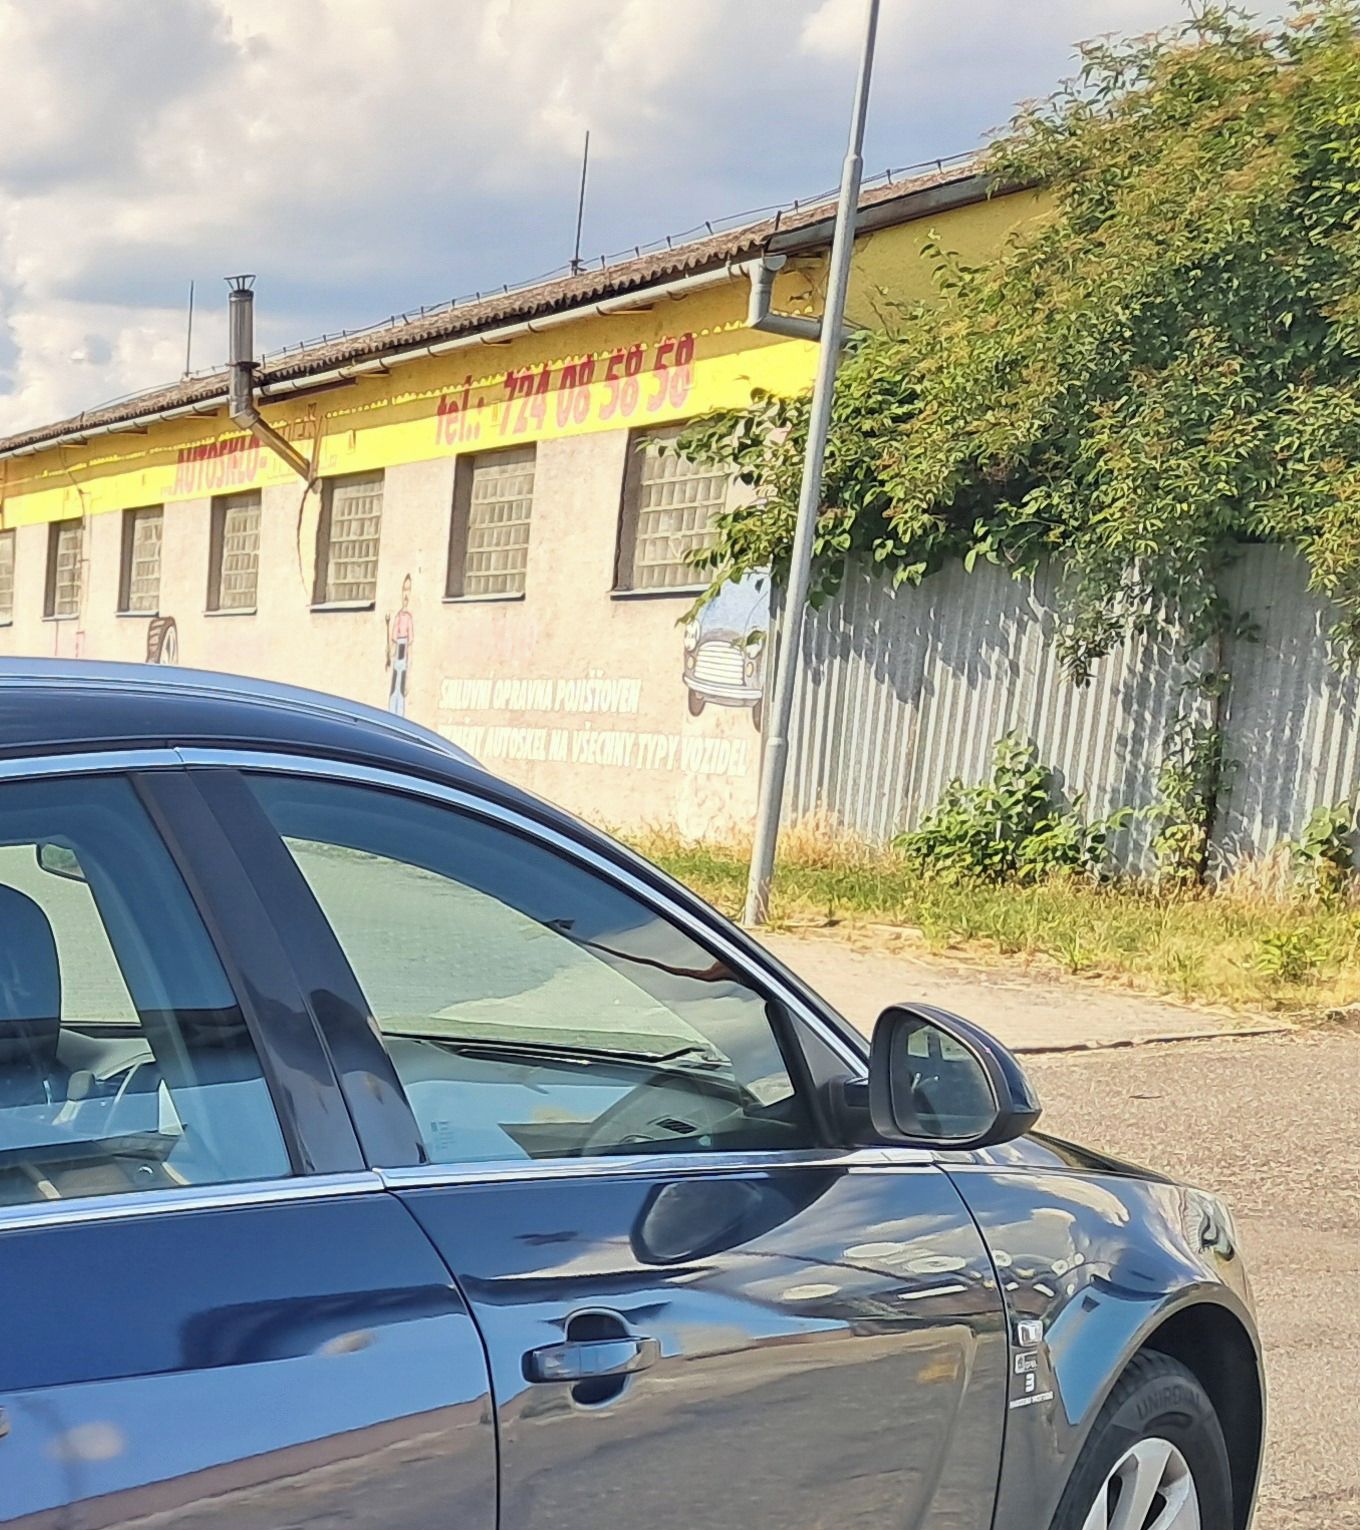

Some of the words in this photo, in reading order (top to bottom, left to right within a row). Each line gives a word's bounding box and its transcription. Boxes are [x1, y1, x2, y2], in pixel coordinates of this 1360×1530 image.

[499, 362, 551, 436] 724
[557, 354, 595, 428] 08
[599, 344, 643, 420] 58
[647, 334, 695, 412] 58
[549, 729, 569, 762] NA
[637, 734, 680, 771] TYPY
[680, 736, 750, 777] VOZIDEL
